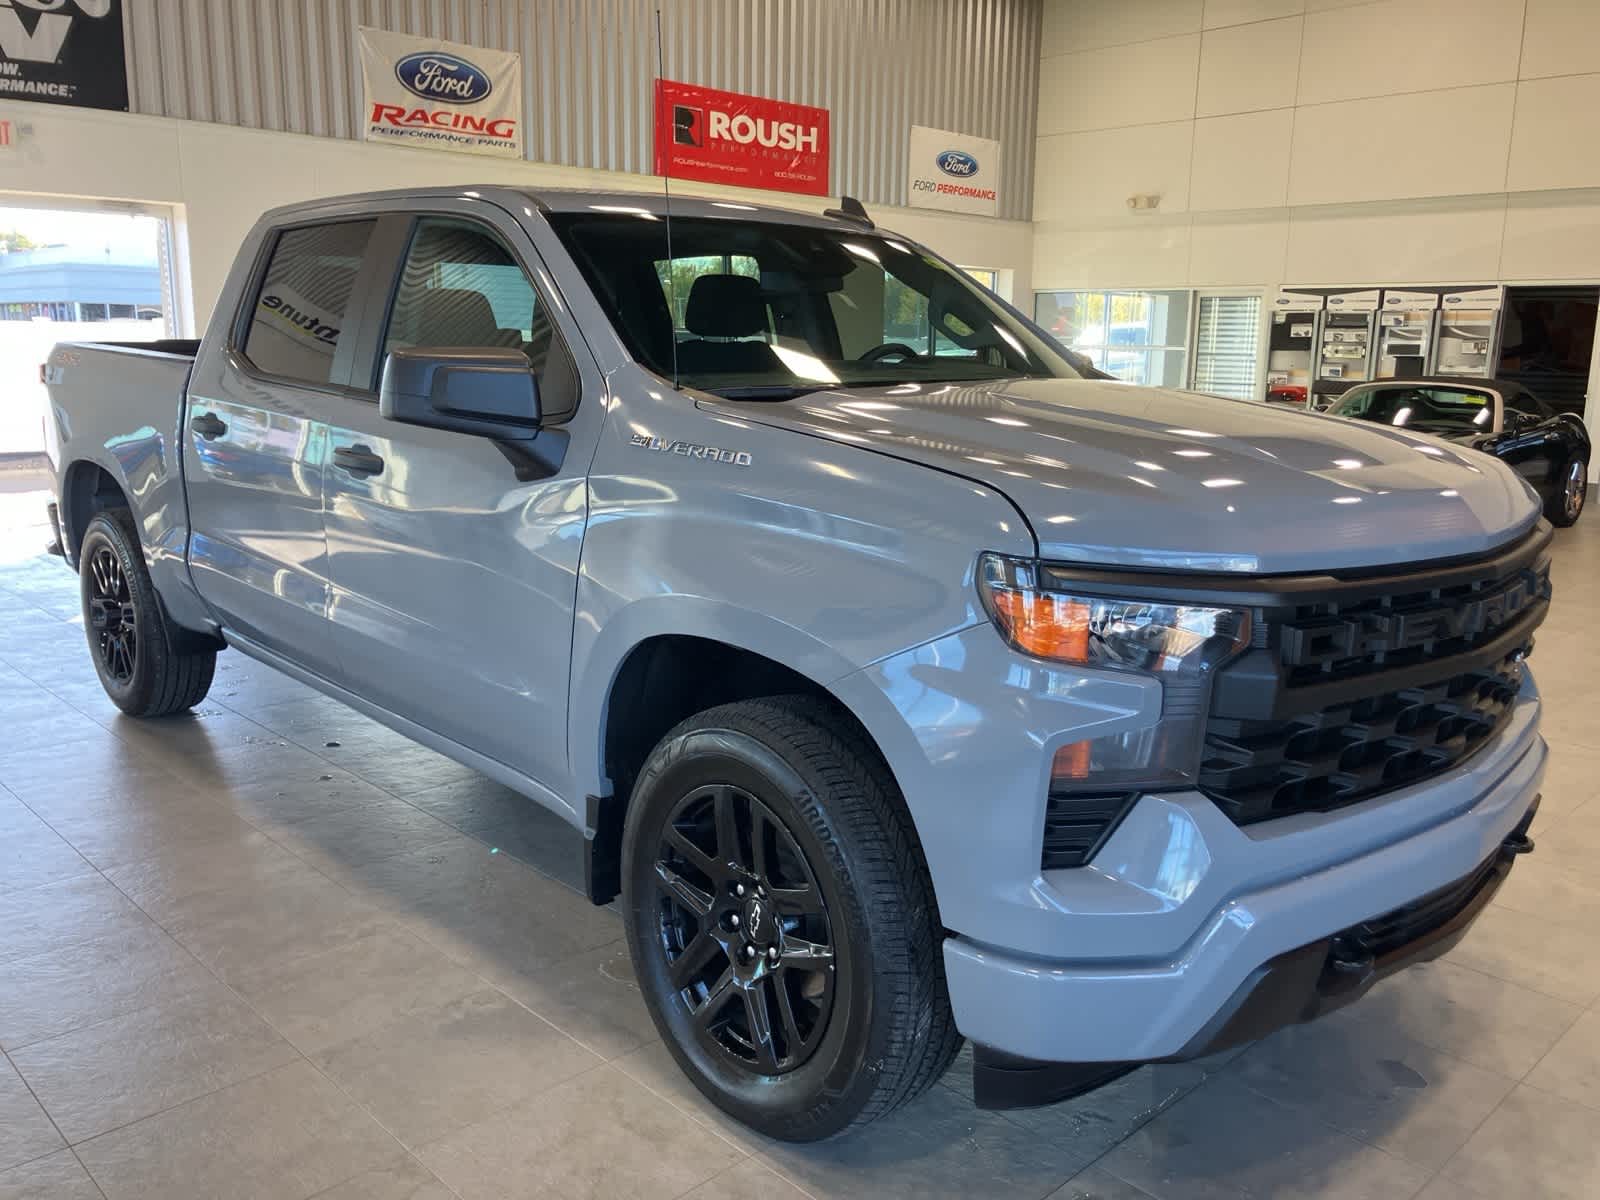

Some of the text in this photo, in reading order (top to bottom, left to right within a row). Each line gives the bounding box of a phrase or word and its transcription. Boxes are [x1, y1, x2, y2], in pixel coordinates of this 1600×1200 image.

[415, 58, 474, 98] Ford
[371, 103, 516, 139] RACING
[371, 126, 517, 150] PERFORMANCE PARTS
[709, 110, 818, 153] ROUSH
[944, 154, 971, 174] Ford
[913, 179, 997, 201] FORD PERFORMANCE
[629, 433, 753, 467] SILVERADO
